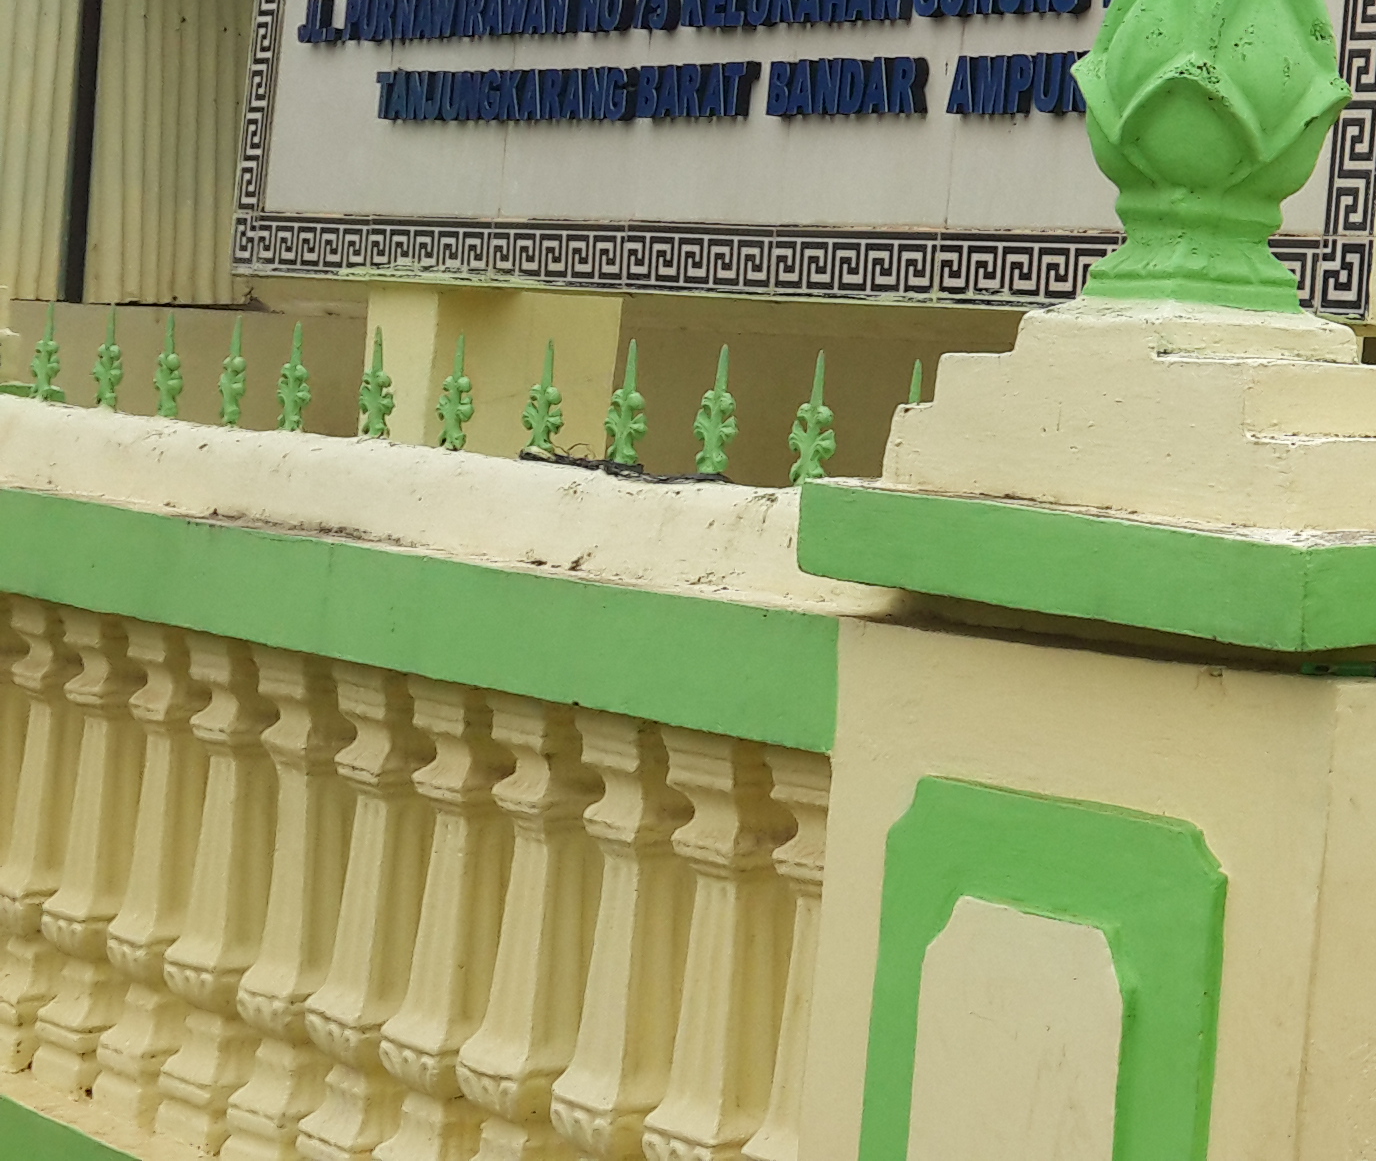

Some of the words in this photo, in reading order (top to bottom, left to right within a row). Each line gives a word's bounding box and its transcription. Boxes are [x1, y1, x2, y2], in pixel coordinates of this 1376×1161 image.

[376, 66, 628, 121] TANJUNGKARANG
[636, 61, 750, 119] BARAT
[766, 56, 920, 115] BANDAR
